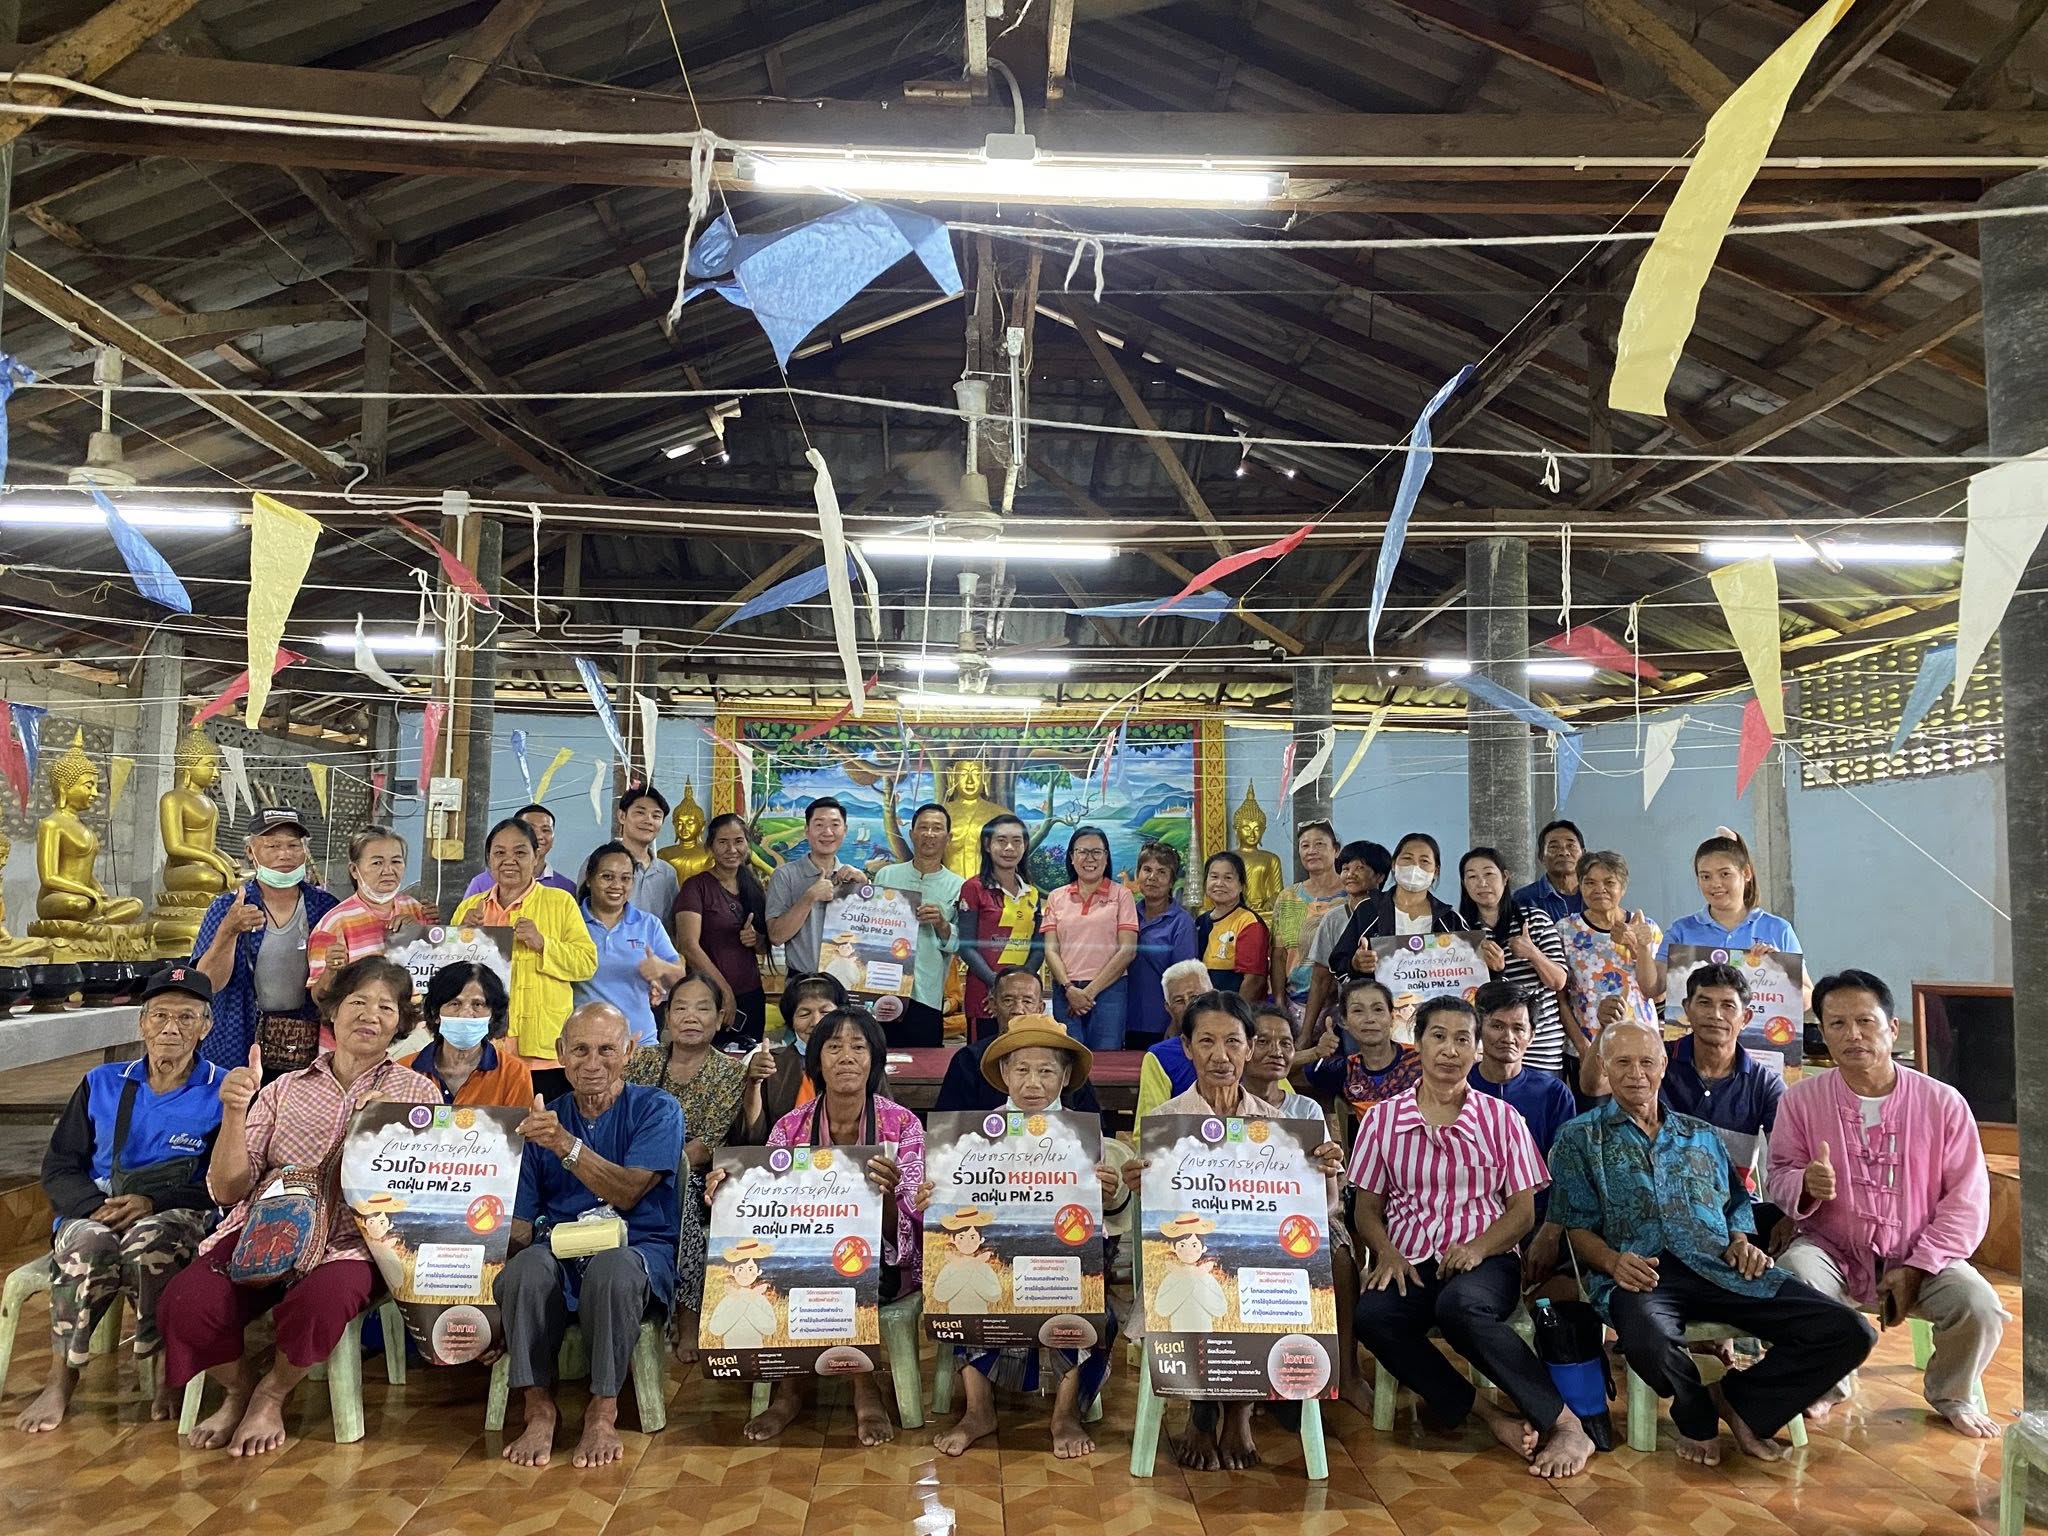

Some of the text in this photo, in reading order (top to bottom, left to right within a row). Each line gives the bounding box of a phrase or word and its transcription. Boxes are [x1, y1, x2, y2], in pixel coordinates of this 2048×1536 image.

[870, 927, 882, 935] PM
[883, 928, 893, 936] 2.5
[1407, 980, 1460, 991] ลดฝุ่น PM 2.5
[387, 1178, 471, 1194] ลดฝุ่น PM 2.5
[971, 1189, 1054, 1206] ลดฝุ่น PM 2.5
[1192, 1197, 1277, 1214] ลดฝุ่น PM 2.5
[752, 1221, 834, 1239] ลดฝุ่น PM 2.5
[1154, 1339, 1185, 1358] หยุด!
[1159, 1359, 1187, 1376] เผา
